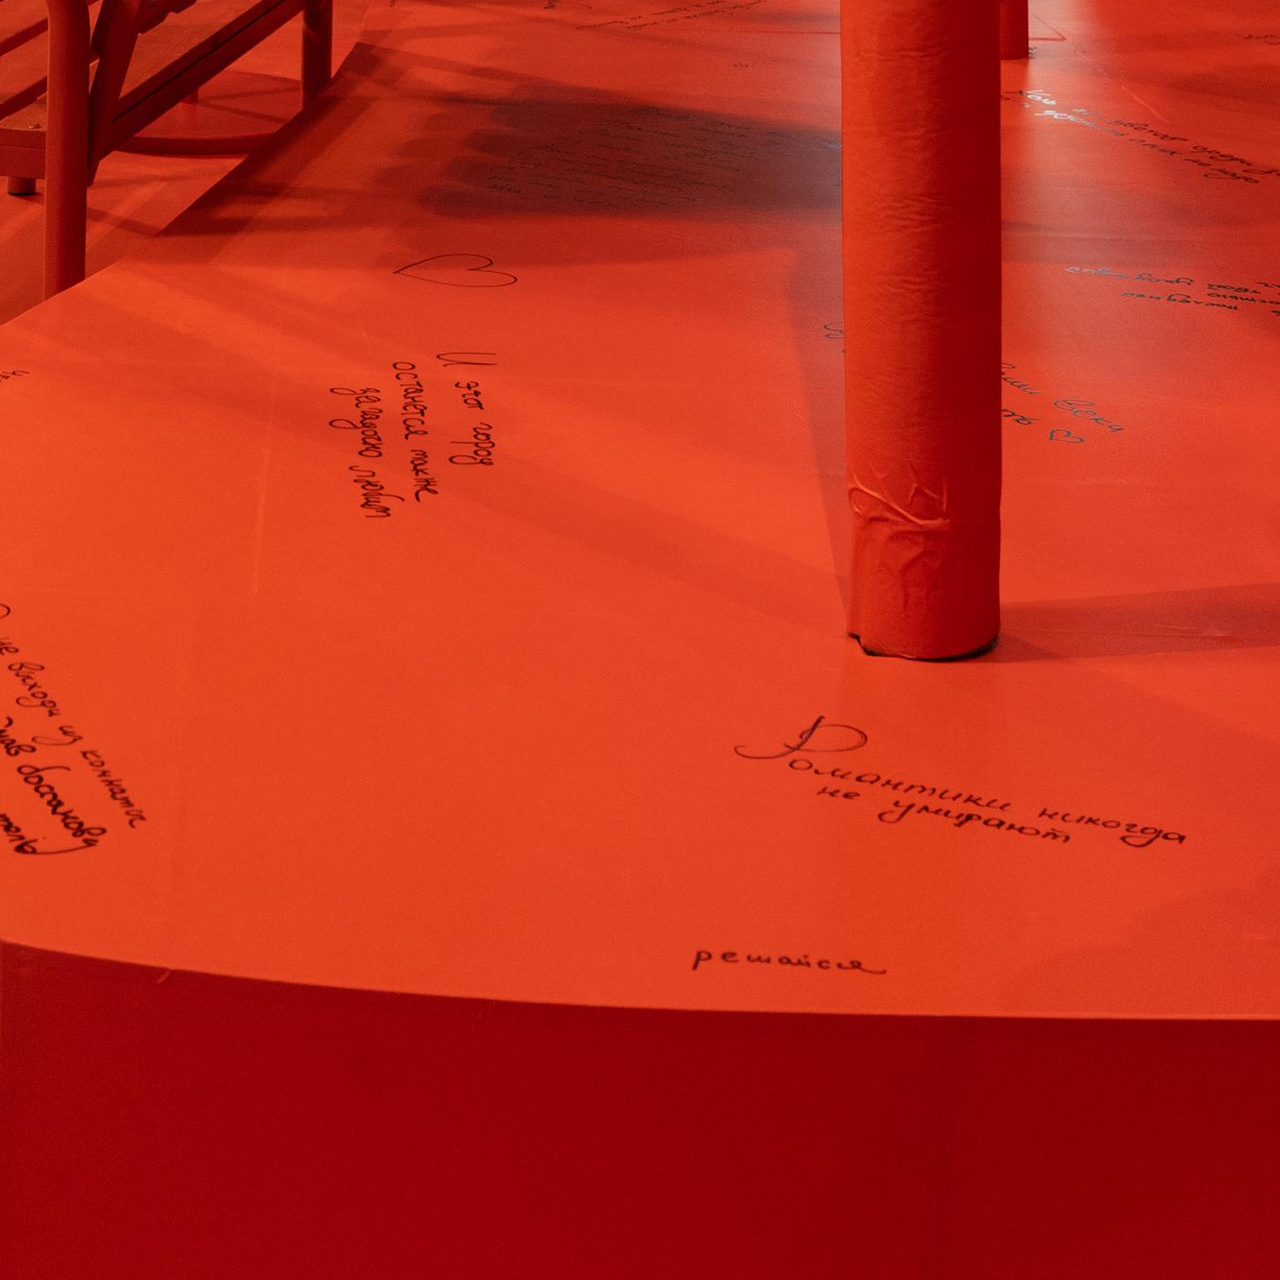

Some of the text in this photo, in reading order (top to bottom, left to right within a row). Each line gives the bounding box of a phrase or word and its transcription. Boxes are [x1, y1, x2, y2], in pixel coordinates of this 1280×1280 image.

[392, 361, 428, 441] останется
[448, 422, 496, 466] город
[6, 661, 61, 719] выходи
[30, 724, 84, 747] из
[733, 714, 1187, 848] Романтики никогда
[816, 787, 1071, 844] не умирают
[691, 947, 887, 976] решайся
